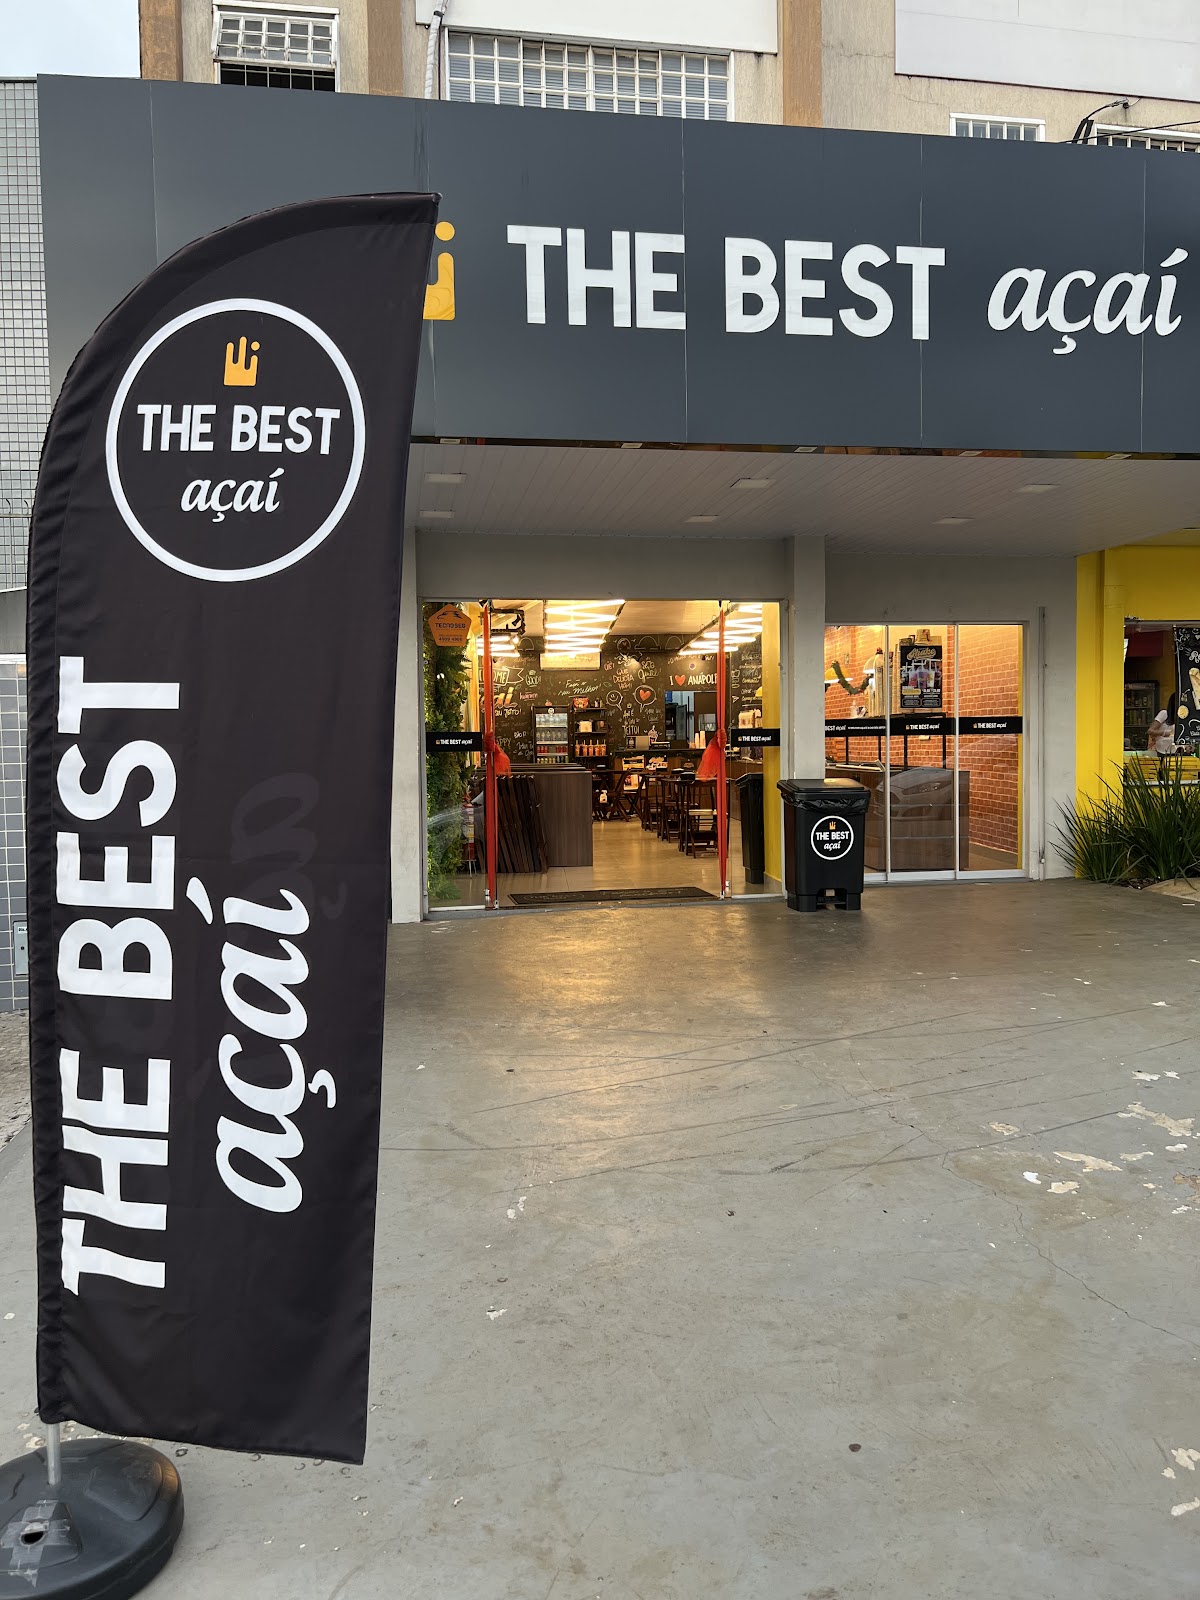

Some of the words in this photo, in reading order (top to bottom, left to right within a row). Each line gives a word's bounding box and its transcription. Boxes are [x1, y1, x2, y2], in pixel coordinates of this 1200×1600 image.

[507, 225, 687, 330] THE
[724, 237, 946, 340] BEST
[987, 247, 1190, 355] açaí
[136, 404, 217, 452] THE
[231, 405, 341, 455] BEST
[180, 467, 285, 523] açaí
[669, 675, 674, 686] I
[687, 671, 718, 686] ANÁPOLI
[56, 656, 181, 1000] BEST
[815, 831, 830, 841] THE
[831, 830, 850, 840] BEST
[823, 840, 842, 851] açaí
[186, 876, 337, 1213] açaí
[61, 1047, 172, 1296] THE
